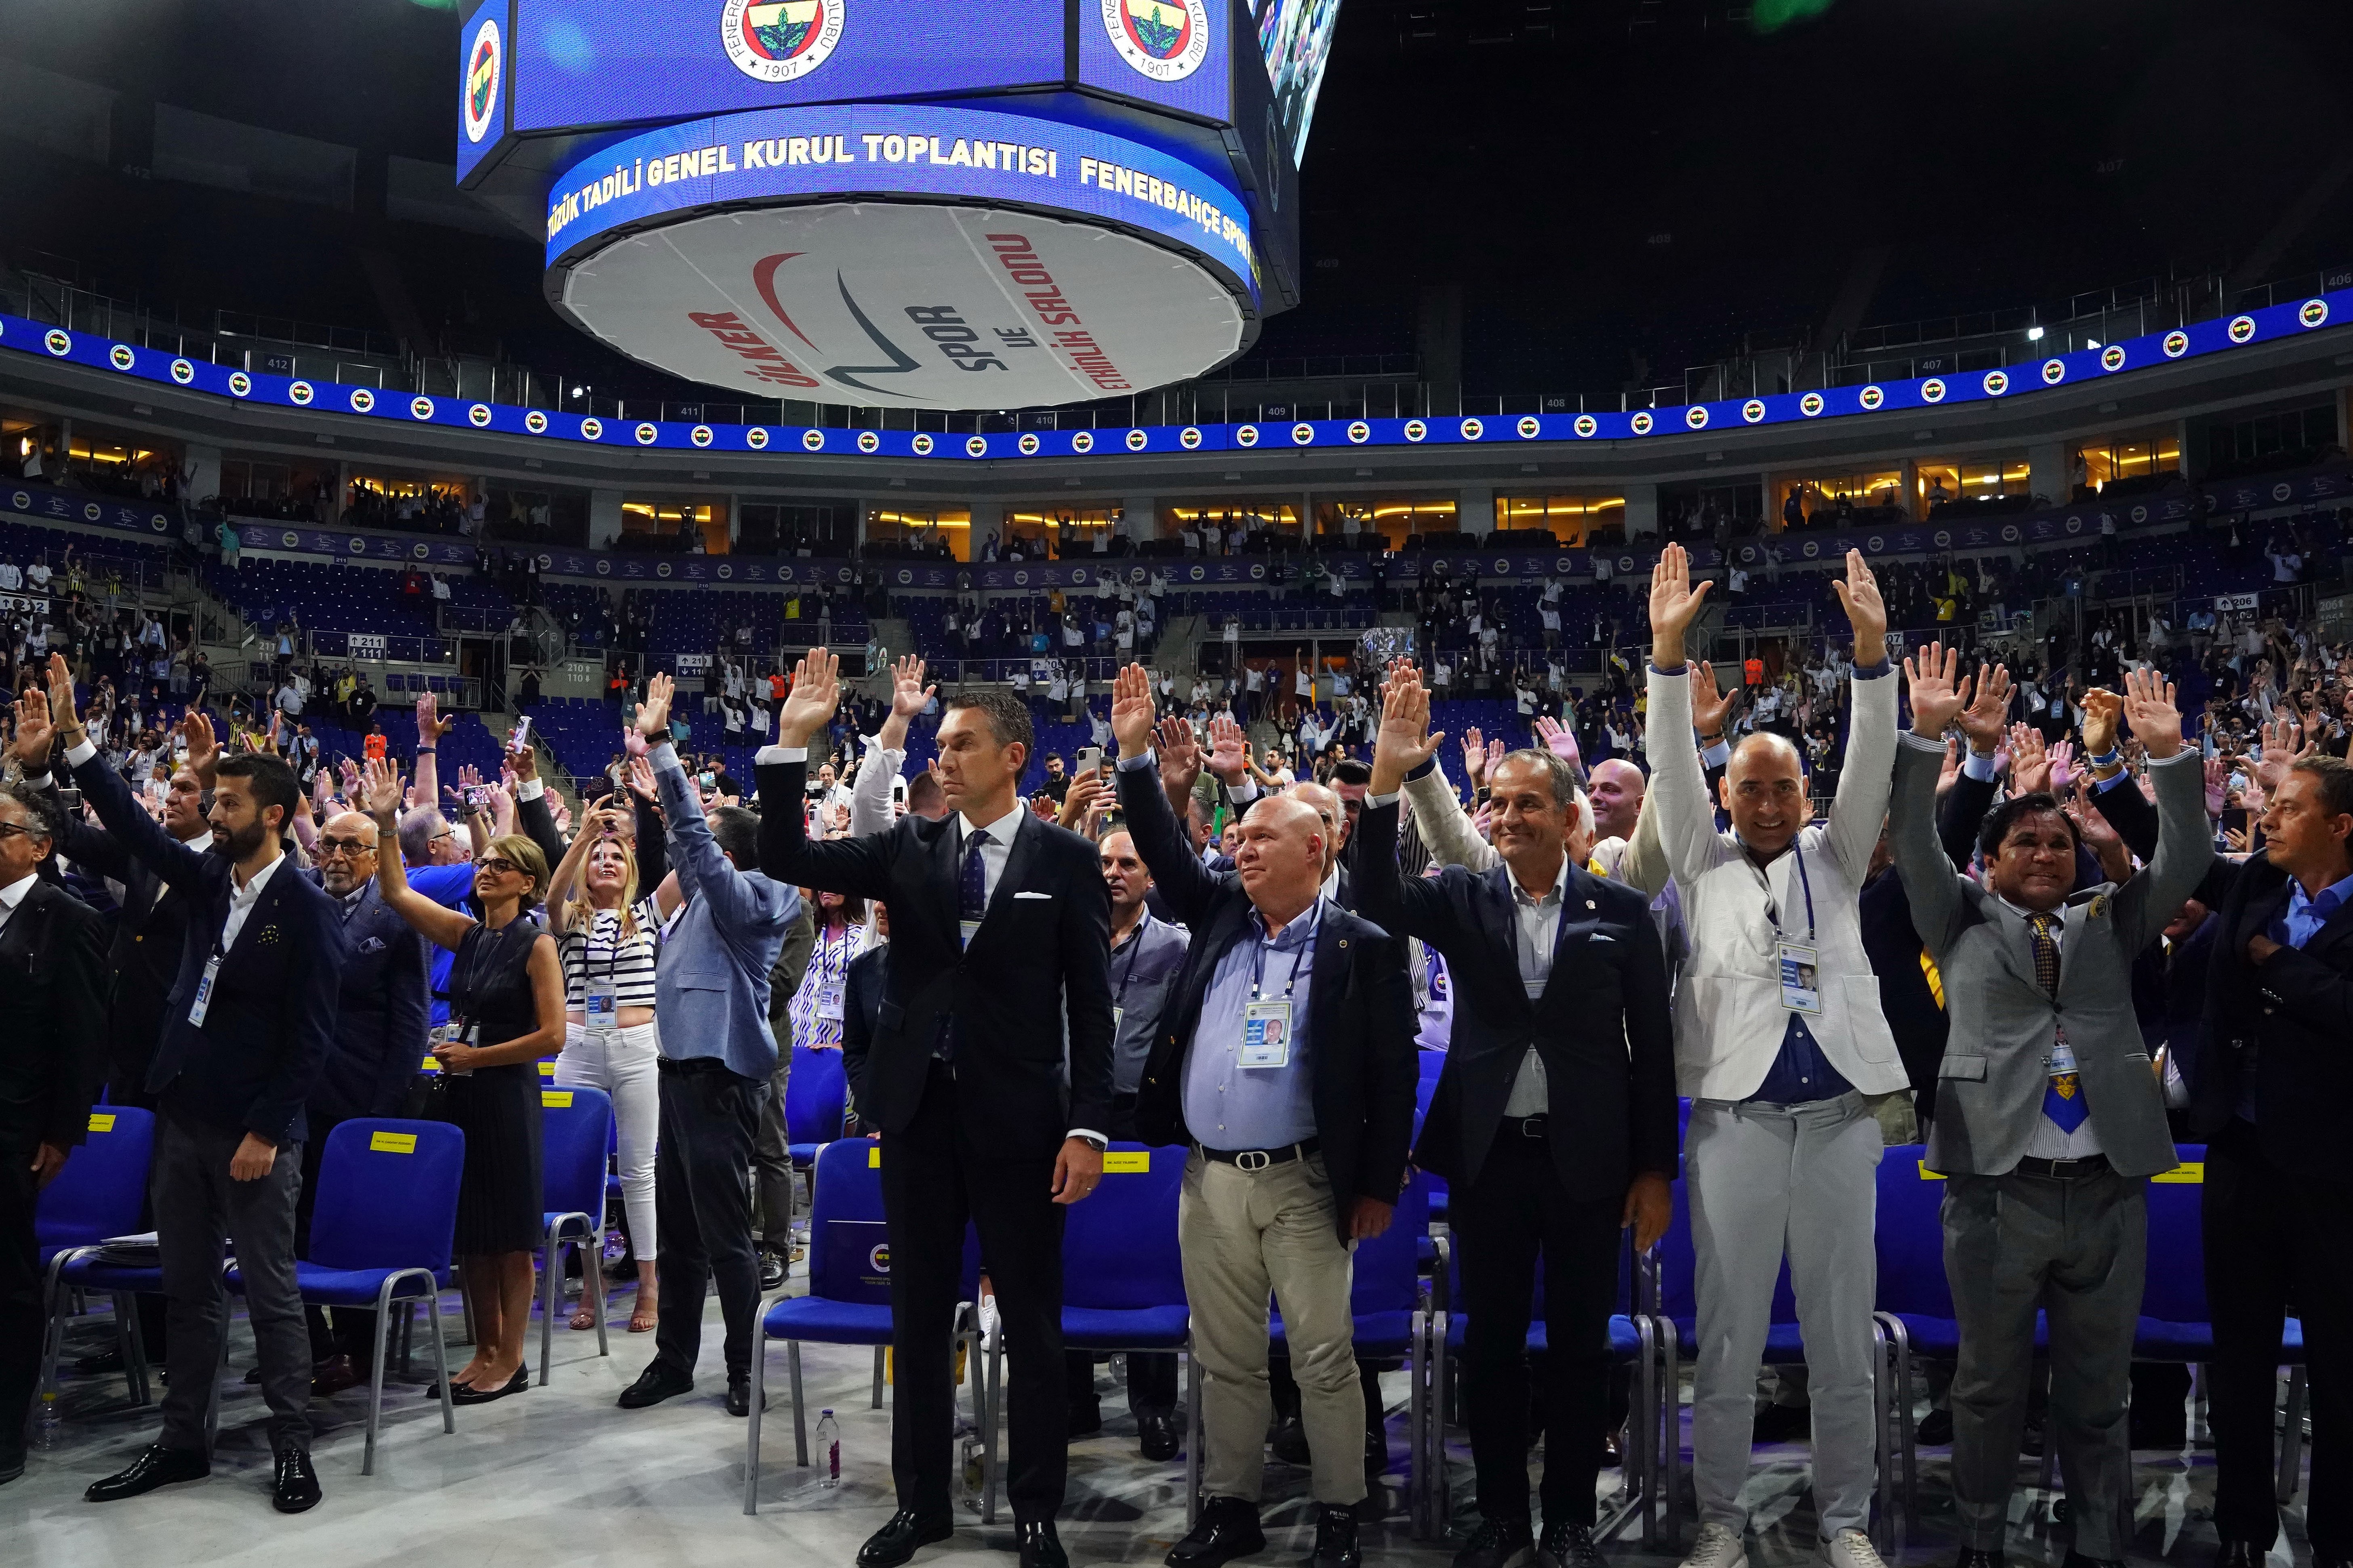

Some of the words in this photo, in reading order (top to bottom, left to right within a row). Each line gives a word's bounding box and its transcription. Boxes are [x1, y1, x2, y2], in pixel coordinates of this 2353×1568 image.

[764, 61, 797, 77] 1907
[1140, 58, 1169, 76] 1907
[548, 192, 580, 242] TÜZÜK
[582, 157, 642, 212] TADİLİ
[647, 145, 736, 187] GENEL
[743, 135, 854, 169] KURUL
[862, 134, 1057, 178] TOPLANTISI
[1080, 156, 1220, 233] FENERBAHÇE
[1223, 215, 1247, 260] SPOR
[985, 234, 1082, 325] SALONU
[2328, 273, 2351, 286] 406
[905, 305, 1009, 372] SPOR
[688, 311, 820, 388] ÜLKER
[267, 359, 287, 368] 412
[1923, 359, 1941, 369] 407
[1547, 399, 1565, 407] 408
[681, 407, 698, 416] 411
[1268, 407, 1285, 416] 409
[1036, 416, 1053, 425] 410
[2234, 598, 2252, 607] 206
[362, 637, 381, 646] 211
[361, 648, 381, 658] 111
[568, 663, 583, 672] 210
[568, 674, 582, 682] 110
[1330, 1510, 1349, 1518] PRADA
